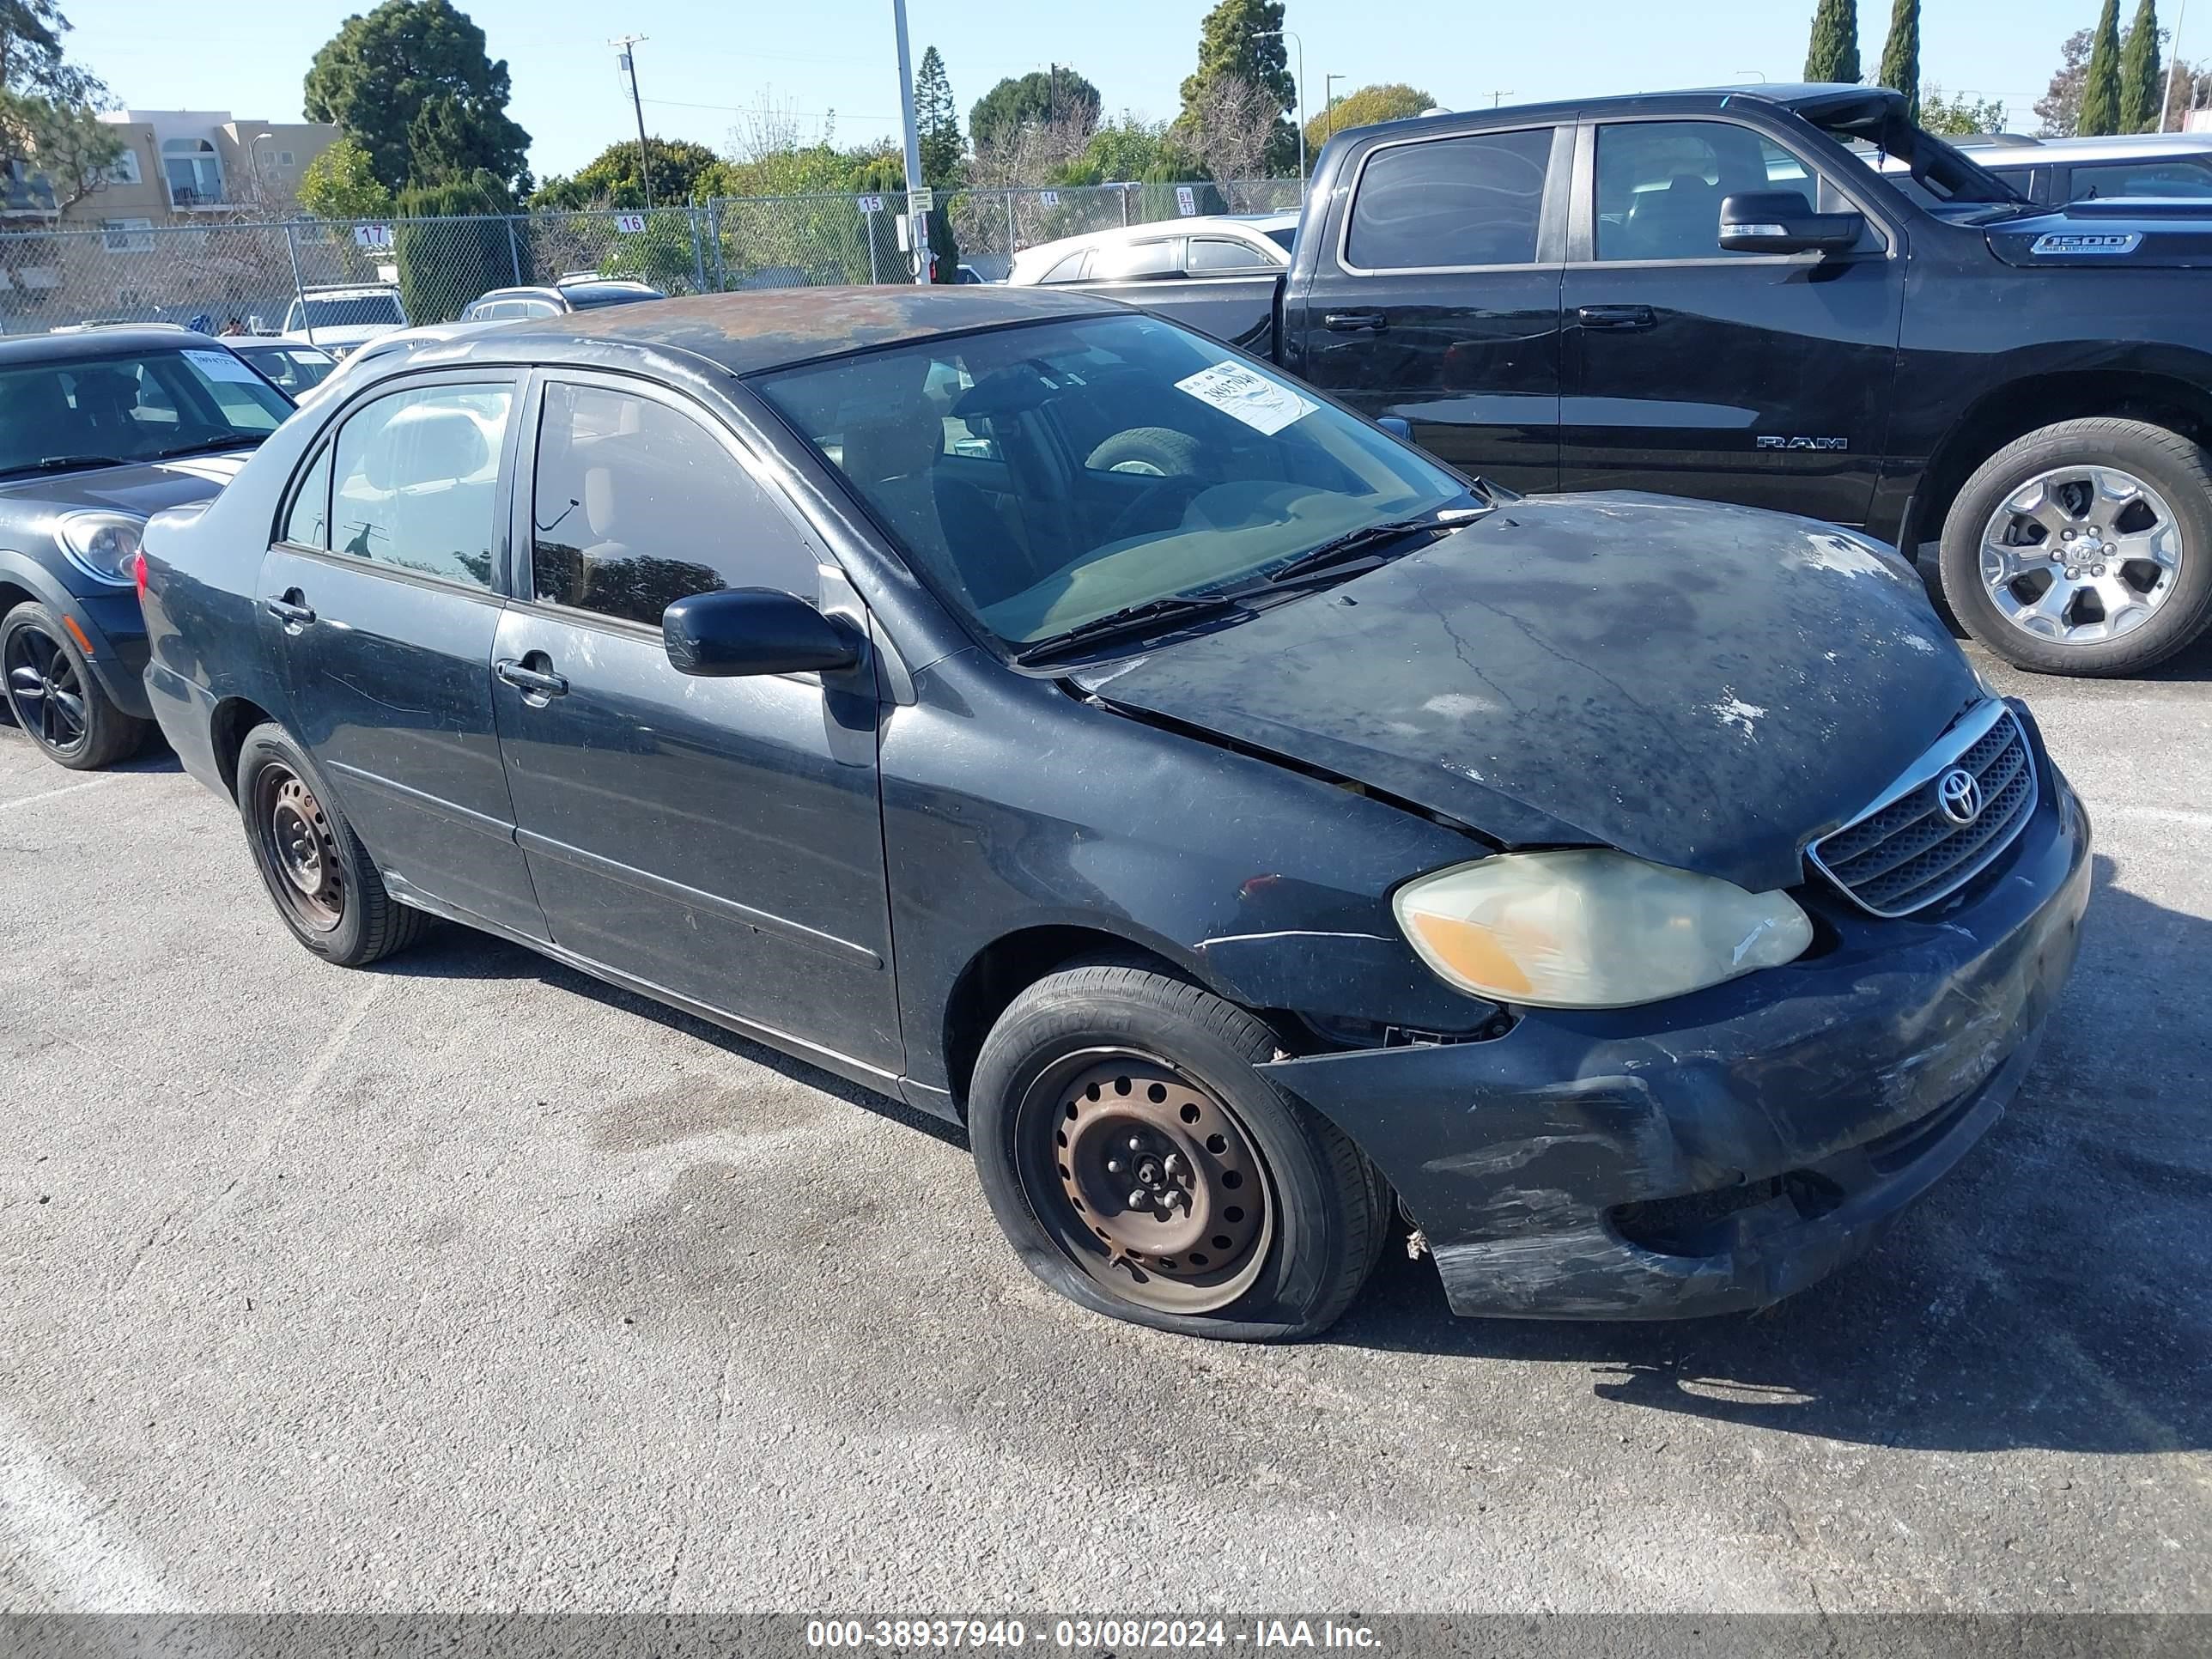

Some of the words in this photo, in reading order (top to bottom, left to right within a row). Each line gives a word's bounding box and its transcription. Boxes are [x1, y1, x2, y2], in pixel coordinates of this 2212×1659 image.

[863, 198, 879, 211] 15
[1044, 192, 1056, 206] 14
[1182, 204, 1194, 214] 13
[623, 216, 641, 231] 16
[362, 227, 382, 243] 17
[2045, 236, 2126, 246] 1500
[1757, 436, 1847, 449] RAM
